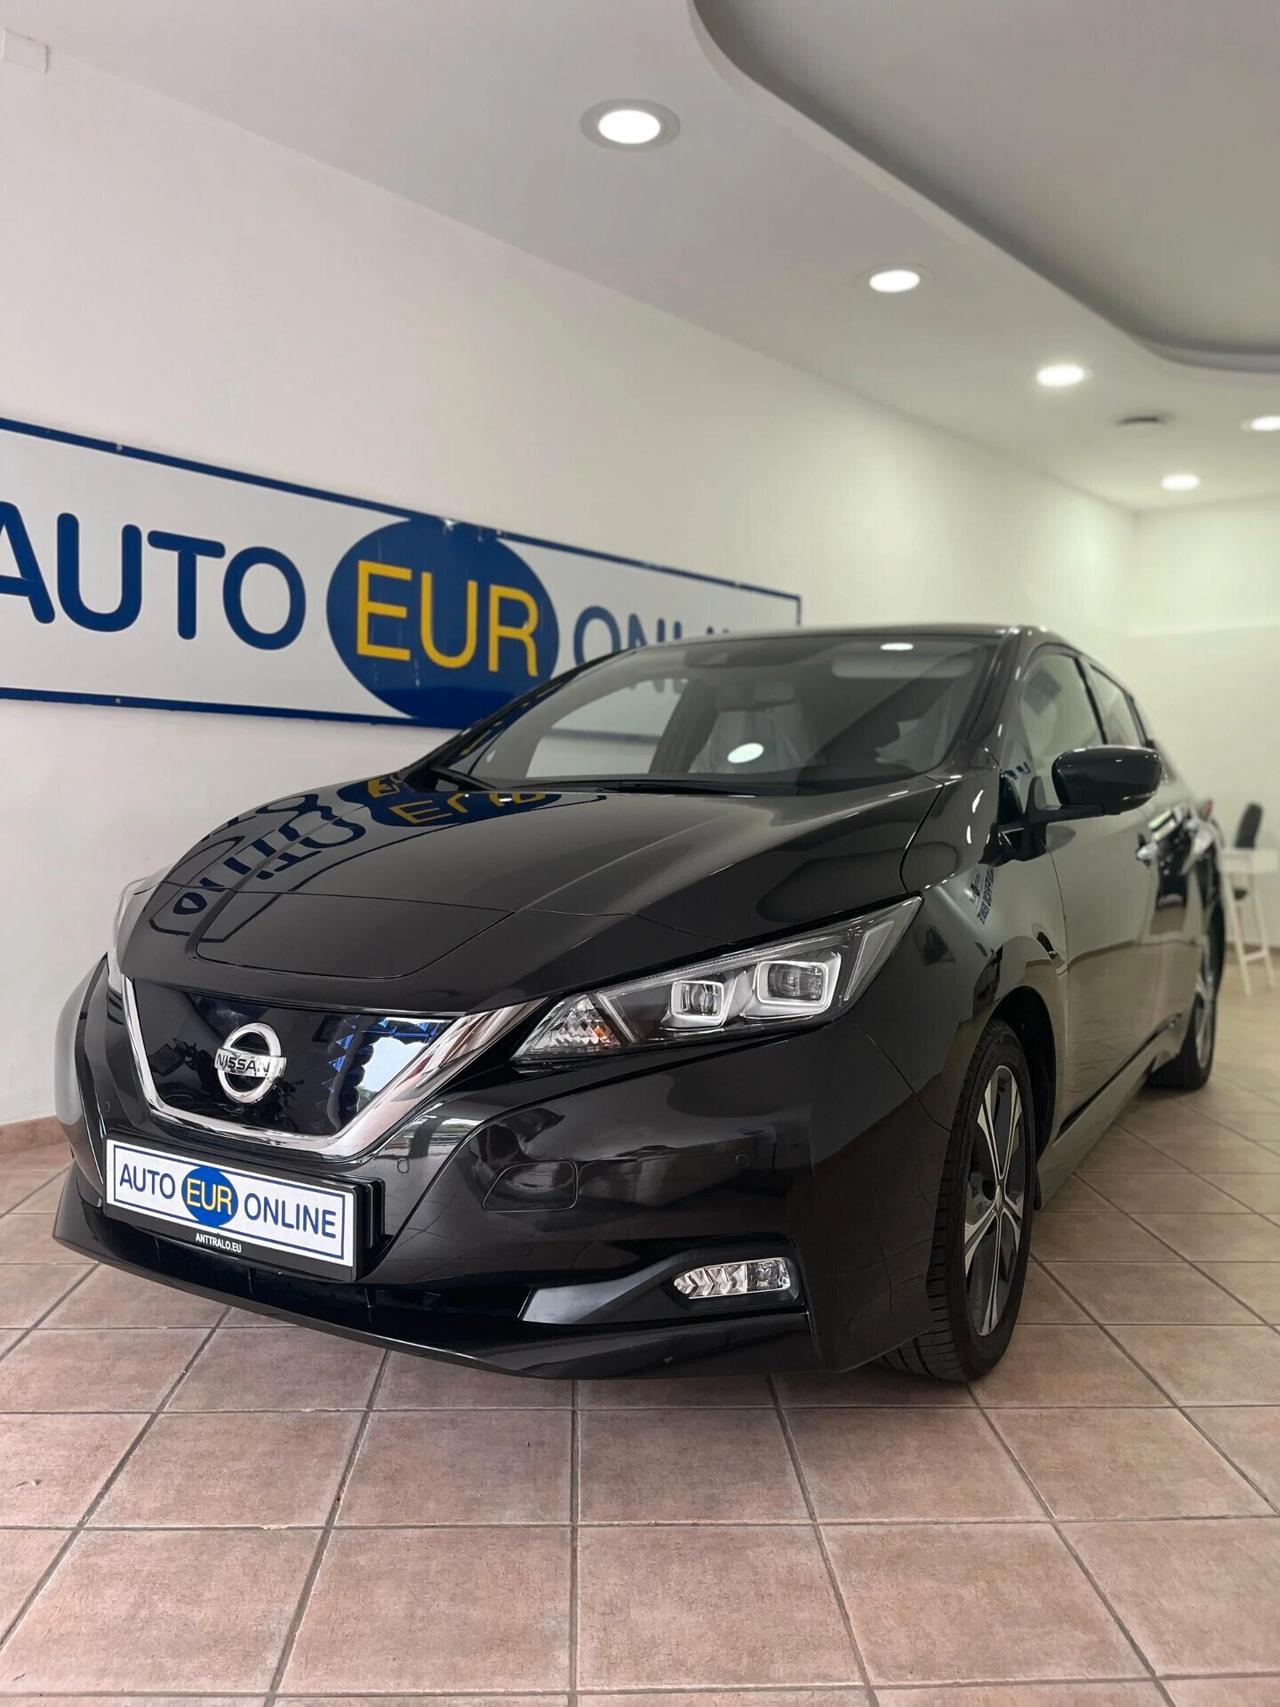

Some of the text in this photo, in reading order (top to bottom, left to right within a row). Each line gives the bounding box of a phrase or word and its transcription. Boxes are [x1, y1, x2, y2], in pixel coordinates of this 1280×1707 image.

[0, 501, 306, 650] AUTO
[357, 560, 538, 677] EUR
[217, 1053, 271, 1073] NISSAN
[119, 1163, 337, 1238] AUTO EUR ONLINE
[195, 1233, 242, 1253] ANTTRALO.EU
